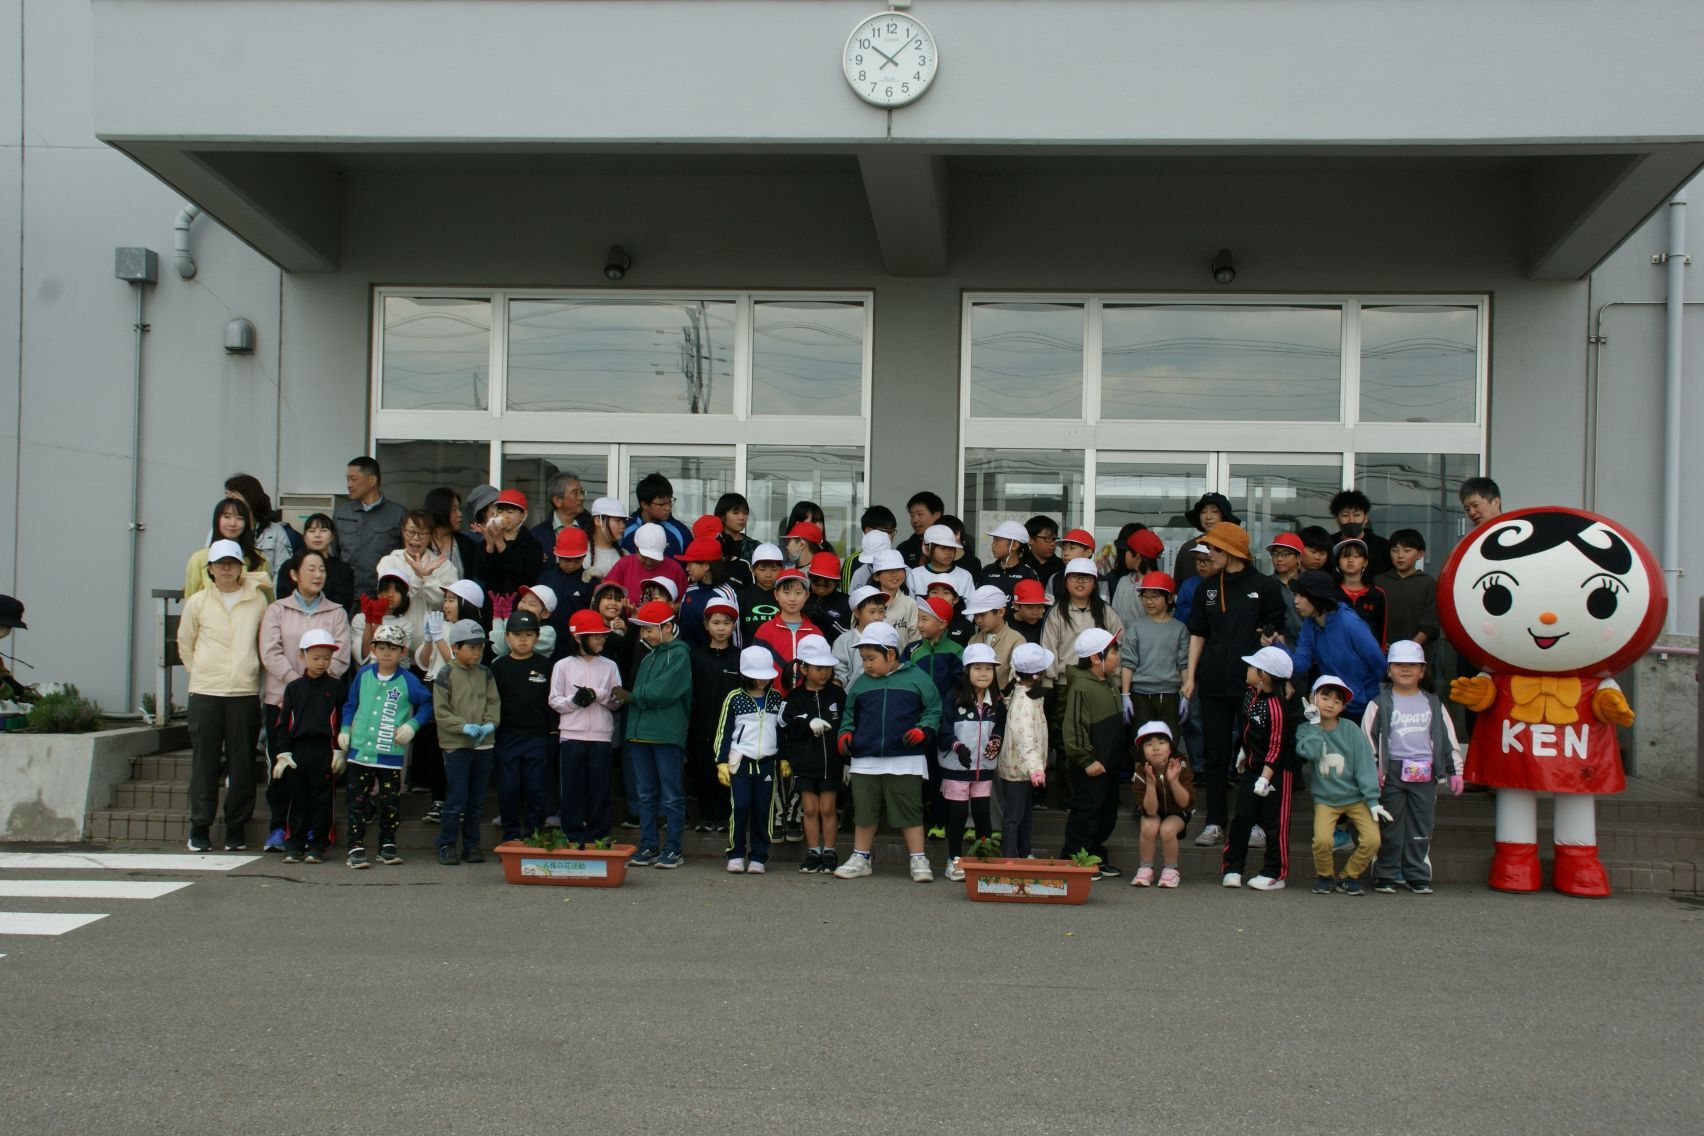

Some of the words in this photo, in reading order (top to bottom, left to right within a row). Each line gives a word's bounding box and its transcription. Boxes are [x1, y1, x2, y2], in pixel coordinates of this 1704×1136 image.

[872, 27, 880, 38] 11
[886, 23, 898, 34] 12
[905, 28, 910, 38] 1
[859, 38, 871, 50] 10
[914, 39, 923, 50] 2
[855, 54, 863, 66] 9
[918, 55, 926, 67] 3
[858, 70, 867, 82] 8
[913, 71, 921, 82] 4
[870, 82, 878, 93] 7
[885, 86, 893, 98] 6
[901, 82, 909, 94] 5
[1502, 719, 1589, 760] KEN
